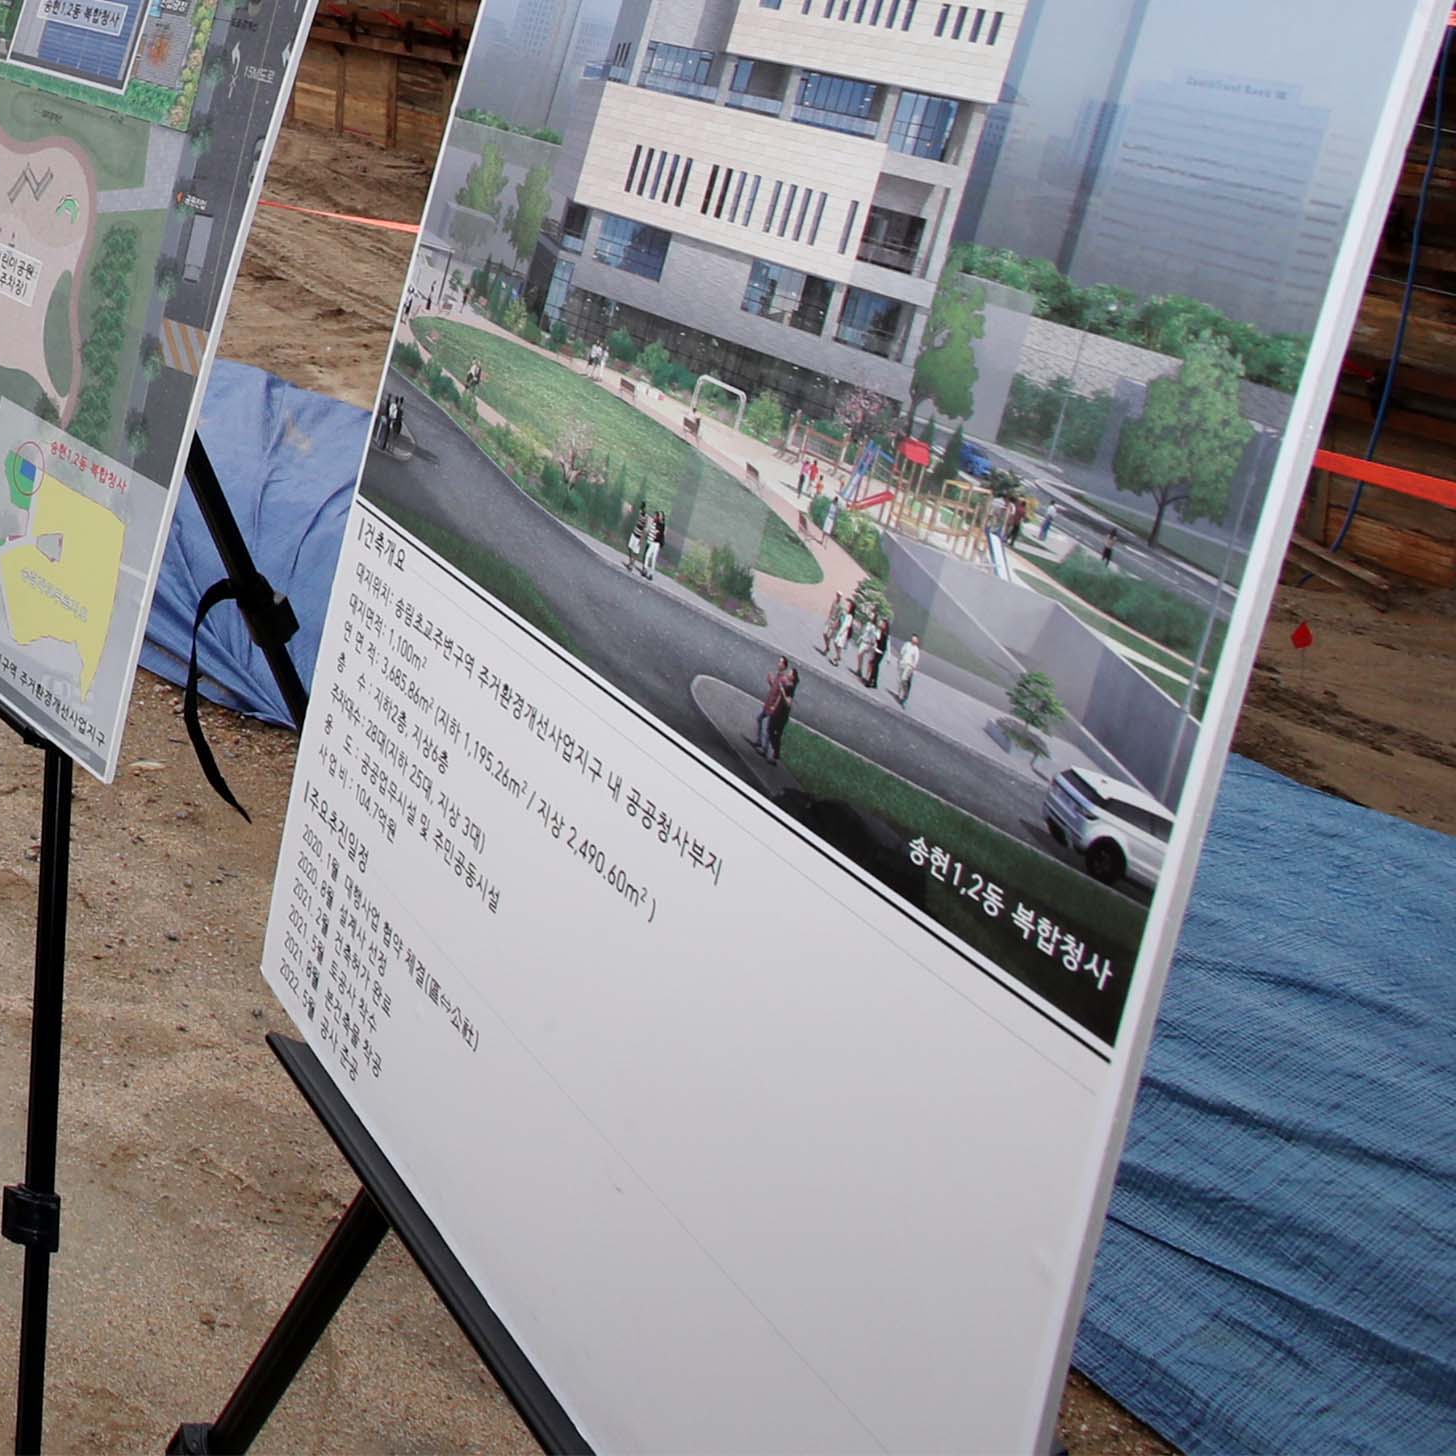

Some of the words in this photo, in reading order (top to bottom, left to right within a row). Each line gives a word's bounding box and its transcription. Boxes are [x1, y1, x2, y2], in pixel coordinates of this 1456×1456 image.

[364, 522, 406, 572] 건축개요
[395, 598, 475, 679] 송림초교주변구역
[477, 665, 602, 783] 주거환경개선사업지구
[607, 771, 622, 802] 내
[626, 787, 722, 886] 공공청사부지
[309, 787, 369, 873] 주요추진일정
[361, 752, 417, 827] 공공업무시설
[419, 813, 430, 842] 및
[433, 828, 500, 914] 주민공동시설
[437, 791, 461, 832] 지상
[537, 798, 565, 839] 지상
[909, 837, 1005, 917] 송현1,2동
[1011, 902, 1113, 991] 복합청사
[368, 940, 387, 977] 선정
[320, 1015, 338, 1054] 공사
